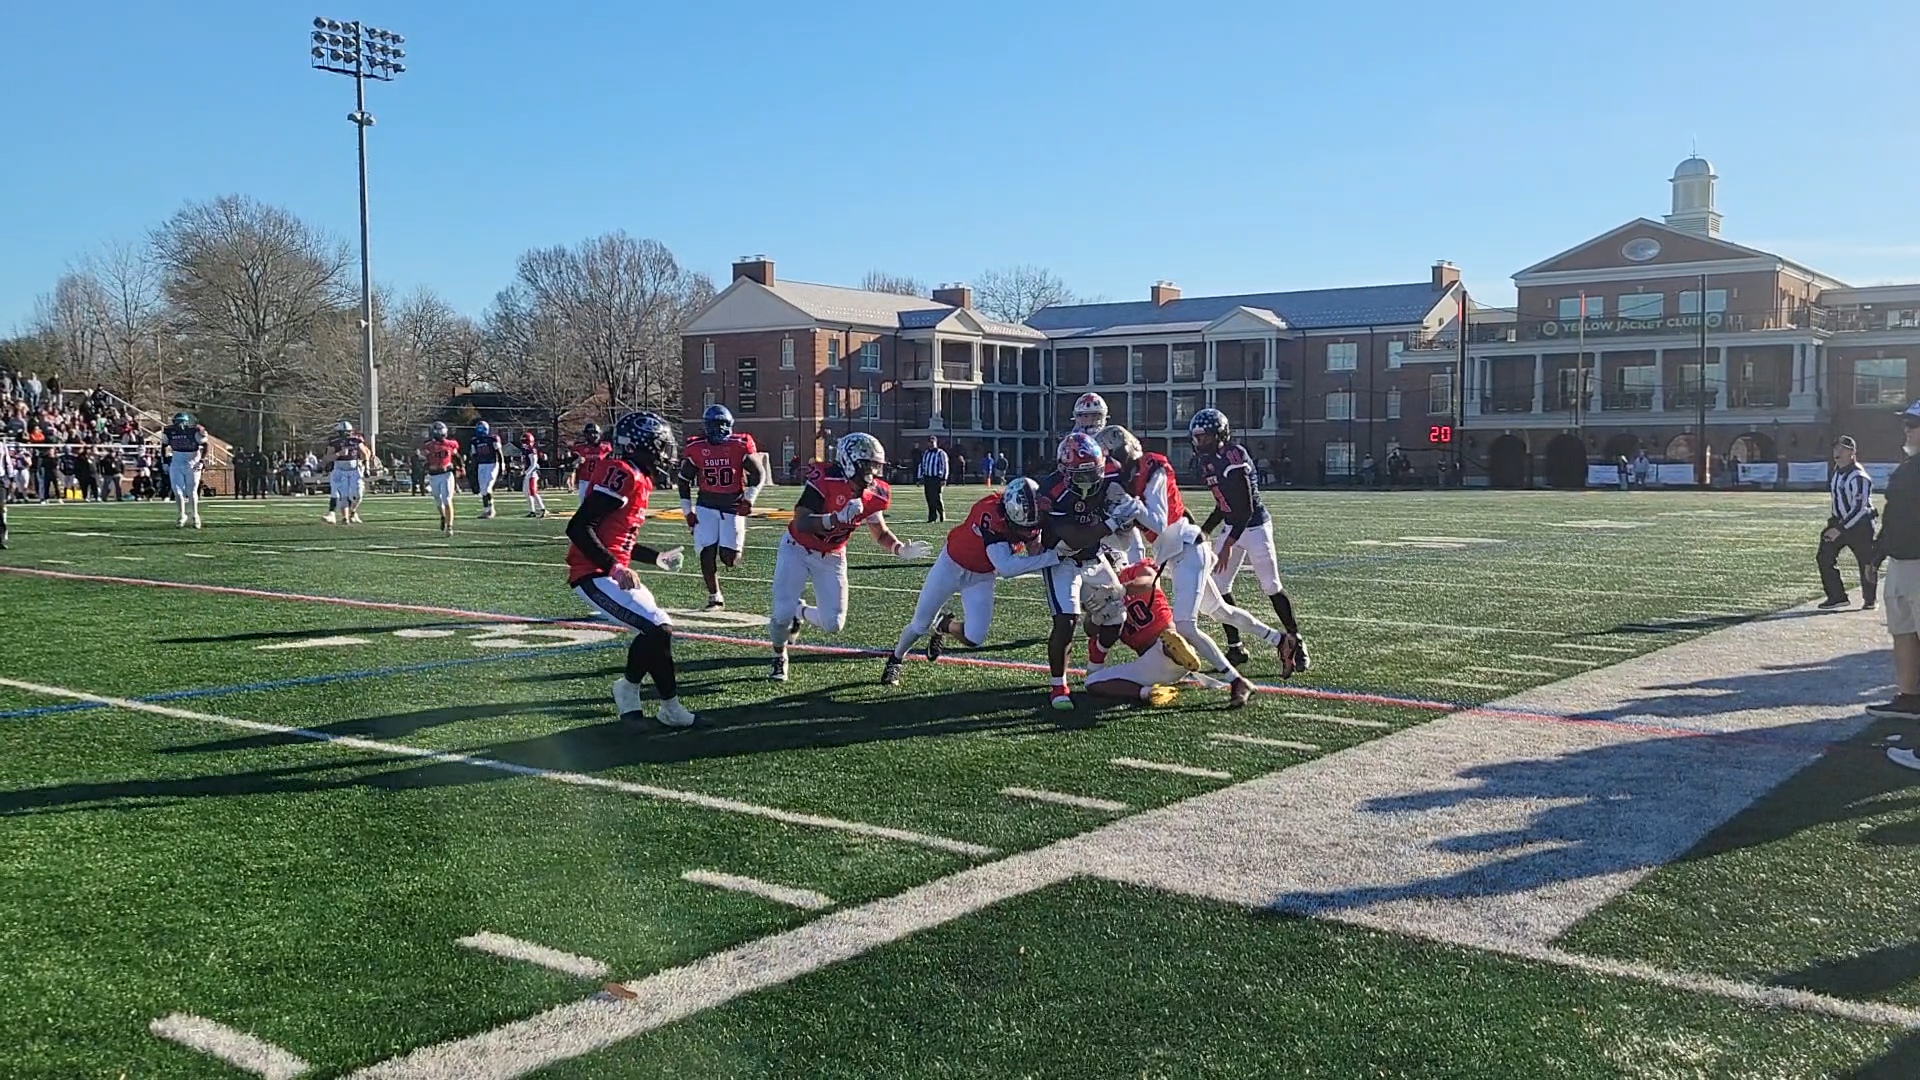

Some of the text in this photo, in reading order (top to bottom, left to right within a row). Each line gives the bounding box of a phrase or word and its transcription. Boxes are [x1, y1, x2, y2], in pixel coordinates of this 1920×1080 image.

[1562, 321, 1613, 332] YELLOW
[1615, 319, 1663, 332] JACKET
[1429, 426, 1451, 442] 20
[704, 458, 730, 467] SOUTH
[603, 465, 628, 493] 13
[703, 466, 734, 487] 50
[980, 511, 993, 530] 6
